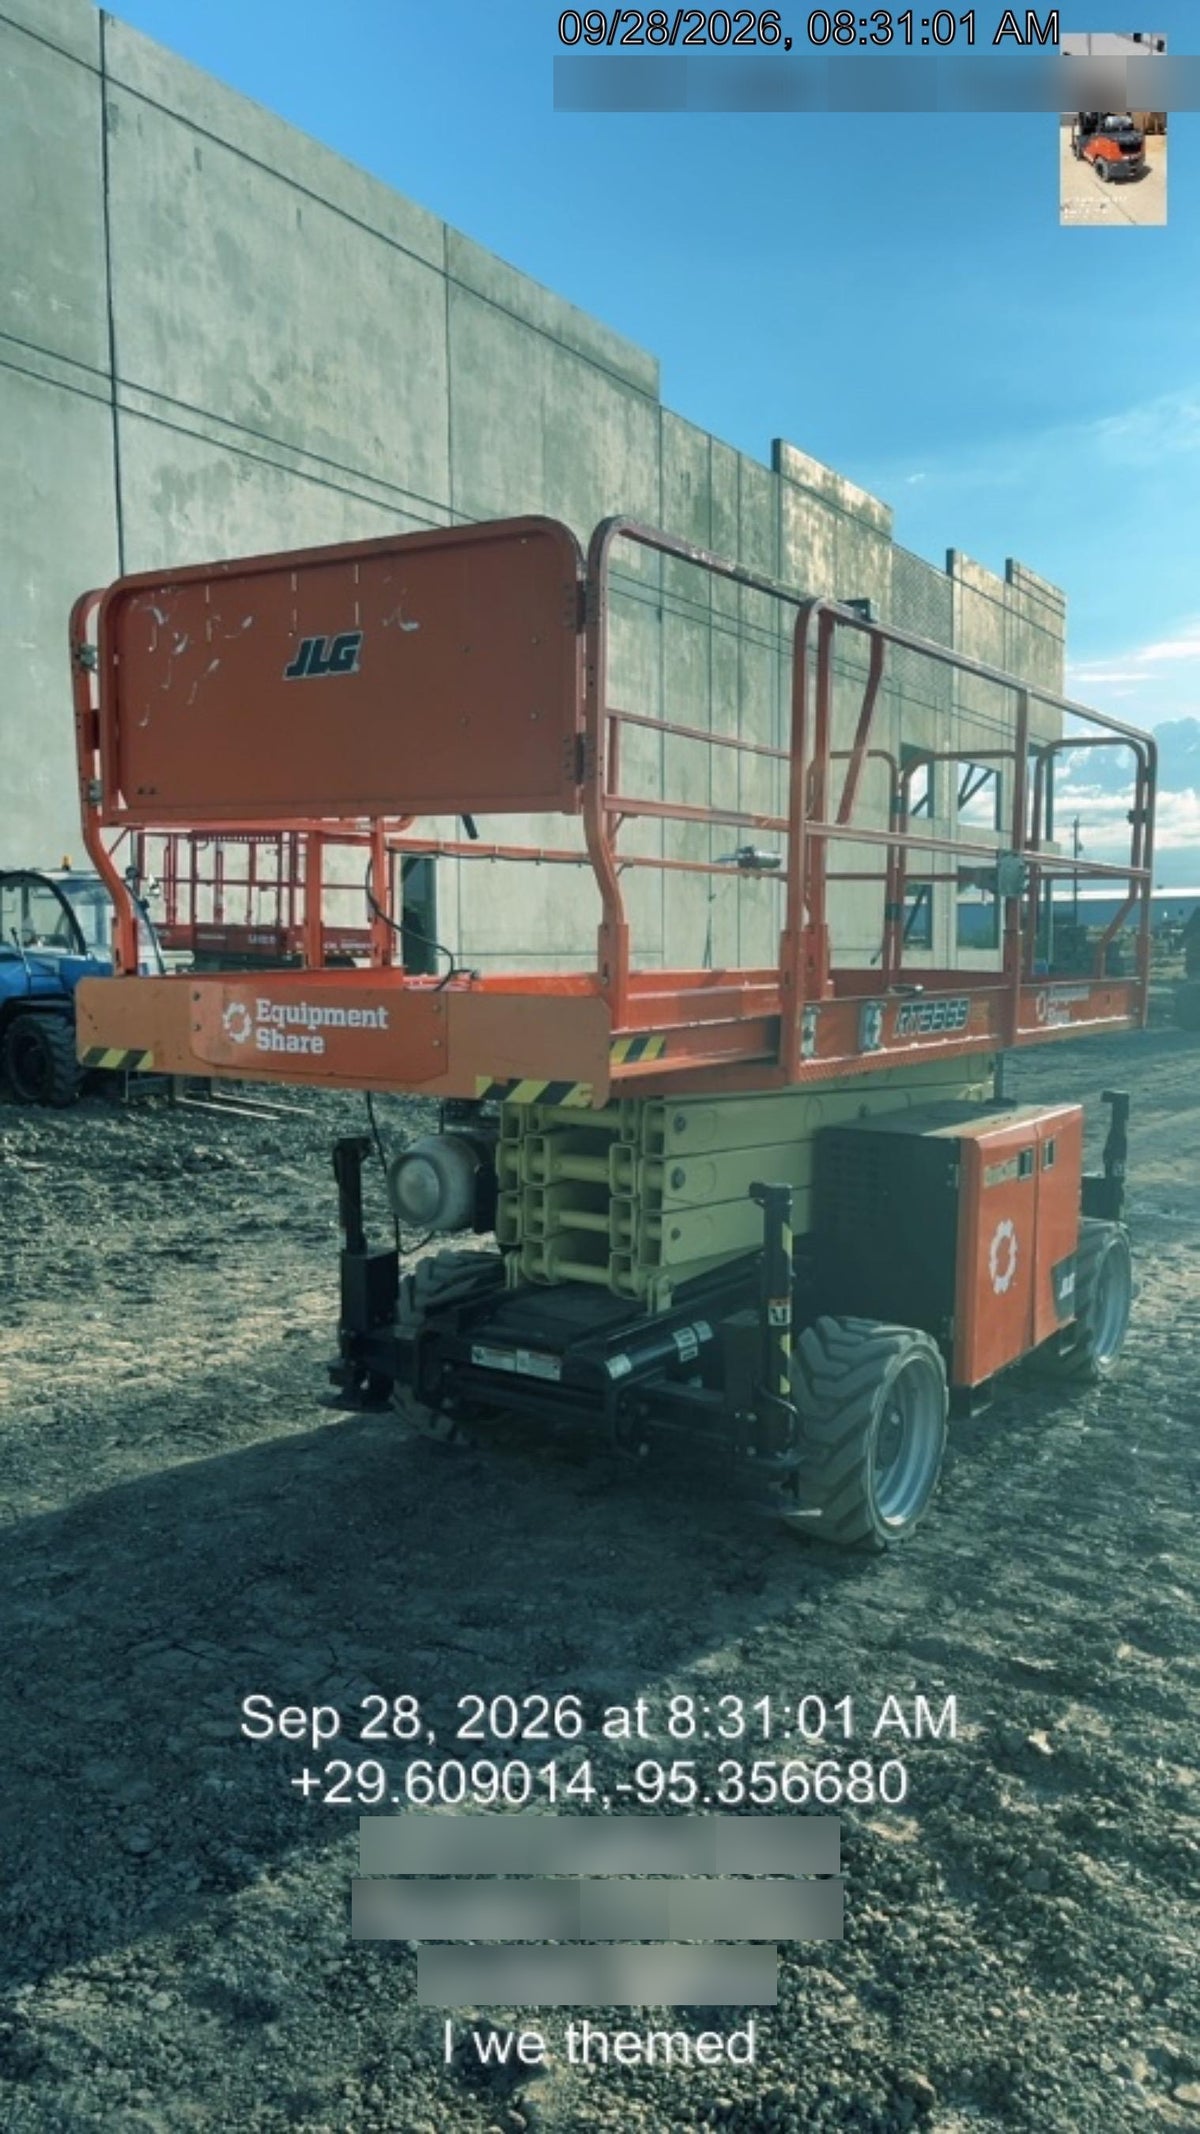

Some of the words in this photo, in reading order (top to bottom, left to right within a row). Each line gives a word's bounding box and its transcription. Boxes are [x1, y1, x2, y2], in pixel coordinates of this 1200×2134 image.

[284, 631, 363, 680] JLG
[256, 998, 389, 1030] Equipment
[256, 1028, 325, 1054] Share
